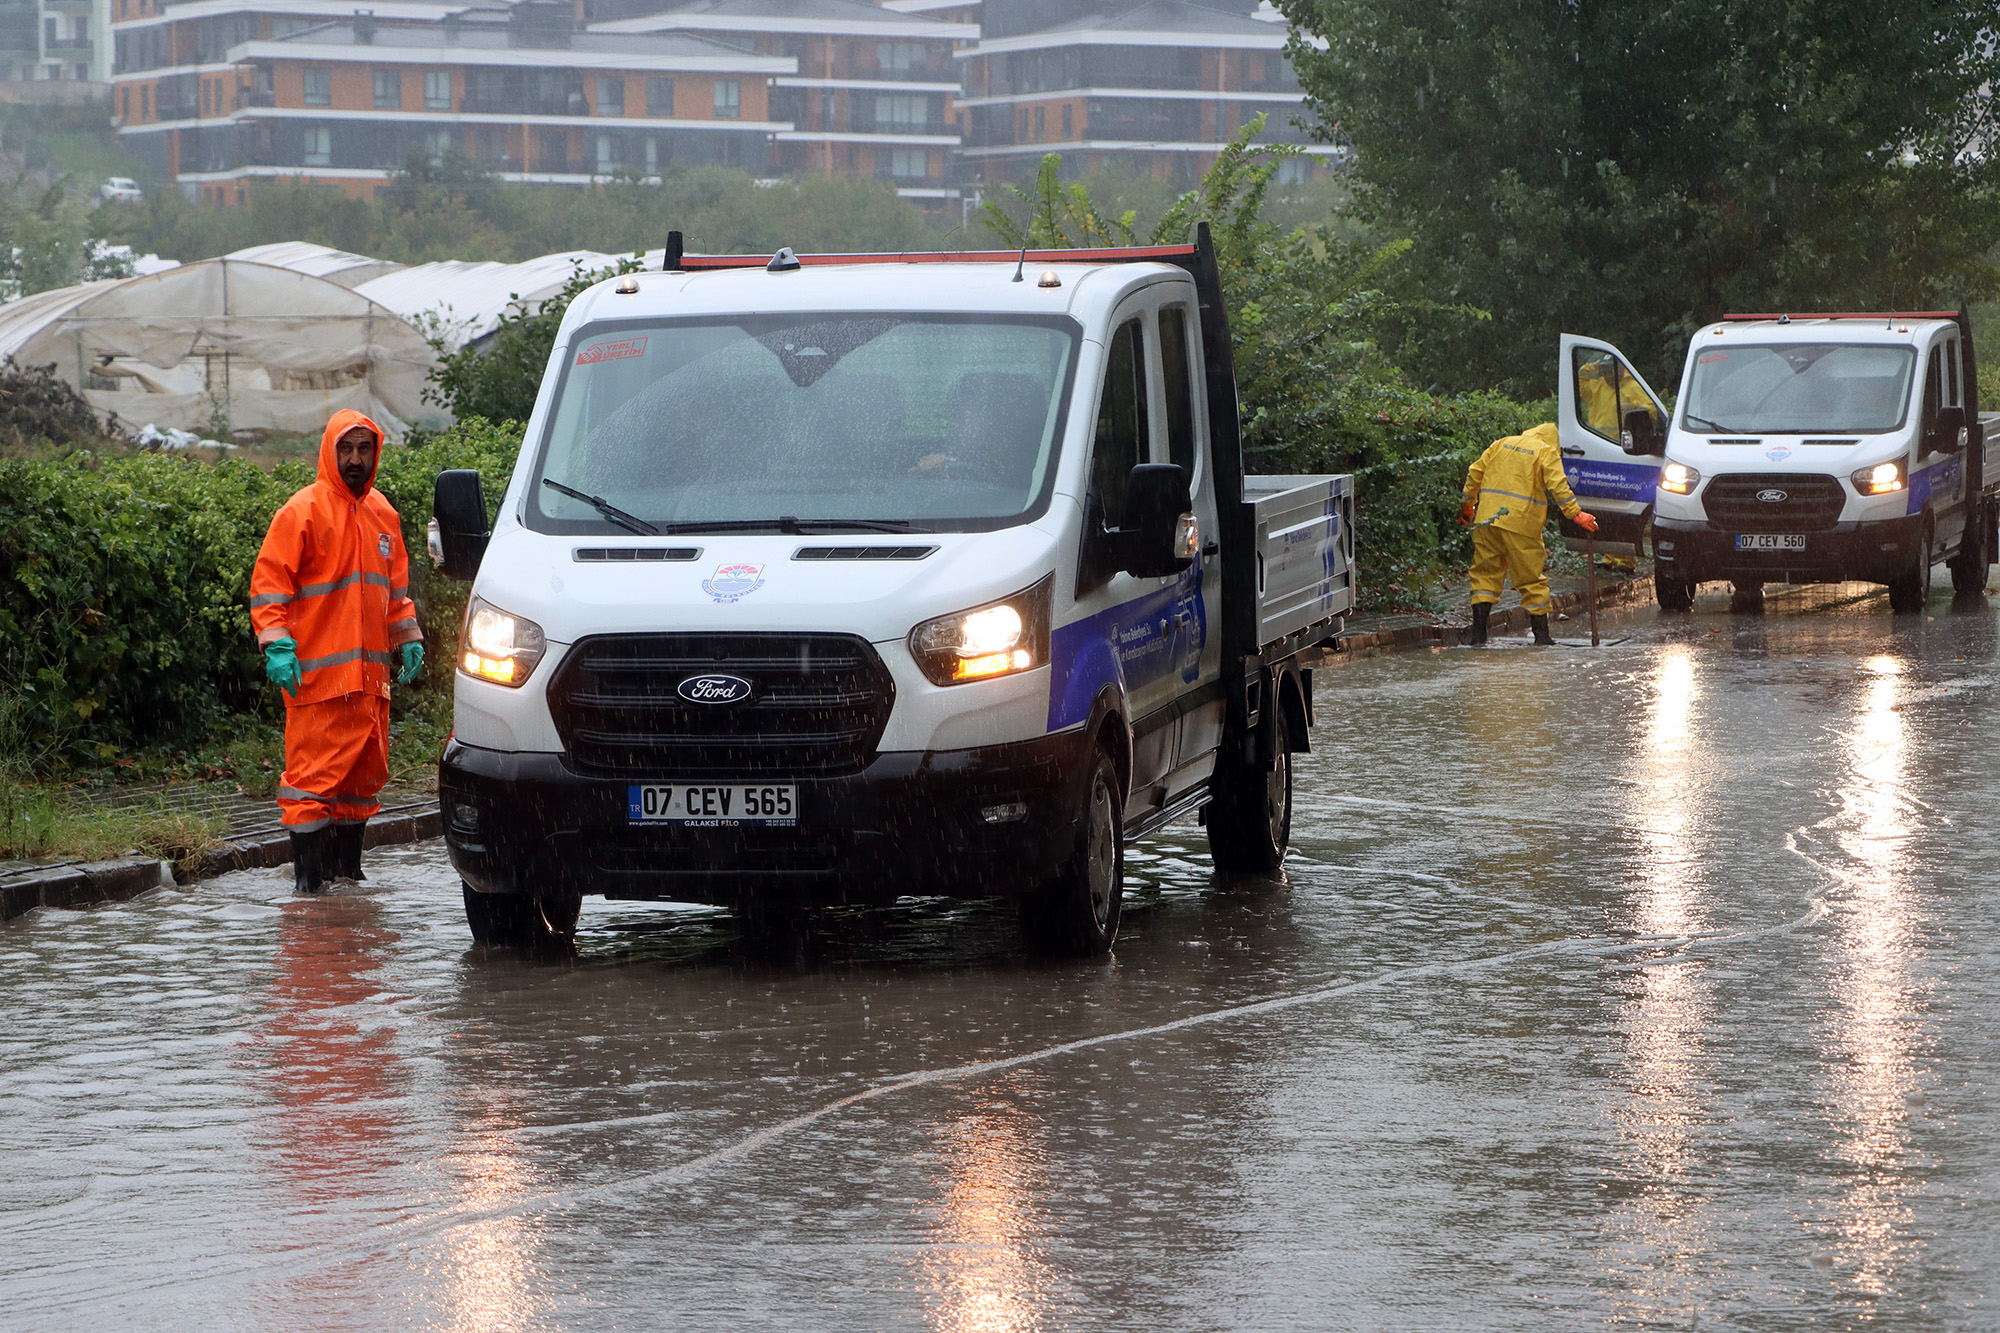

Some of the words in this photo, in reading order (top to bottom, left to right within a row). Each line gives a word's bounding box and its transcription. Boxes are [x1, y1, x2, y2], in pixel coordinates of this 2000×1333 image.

[606, 341, 635, 351] YERLİ
[603, 348, 641, 358] ÜRETİM
[1596, 472, 1620, 481] Belediyesi
[1620, 474, 1627, 482] Su
[1762, 491, 1782, 500] Ford
[1741, 535, 1755, 548] 07
[1758, 535, 1779, 548] CEV
[1784, 535, 1804, 548] 560
[691, 679, 737, 698] Ford
[630, 804, 641, 812] TR
[643, 788, 673, 815] 07
[686, 788, 732, 815] CEV
[744, 788, 791, 815] 565
[684, 819, 719, 827] GALAKSİ
[720, 819, 740, 827] FİLO
